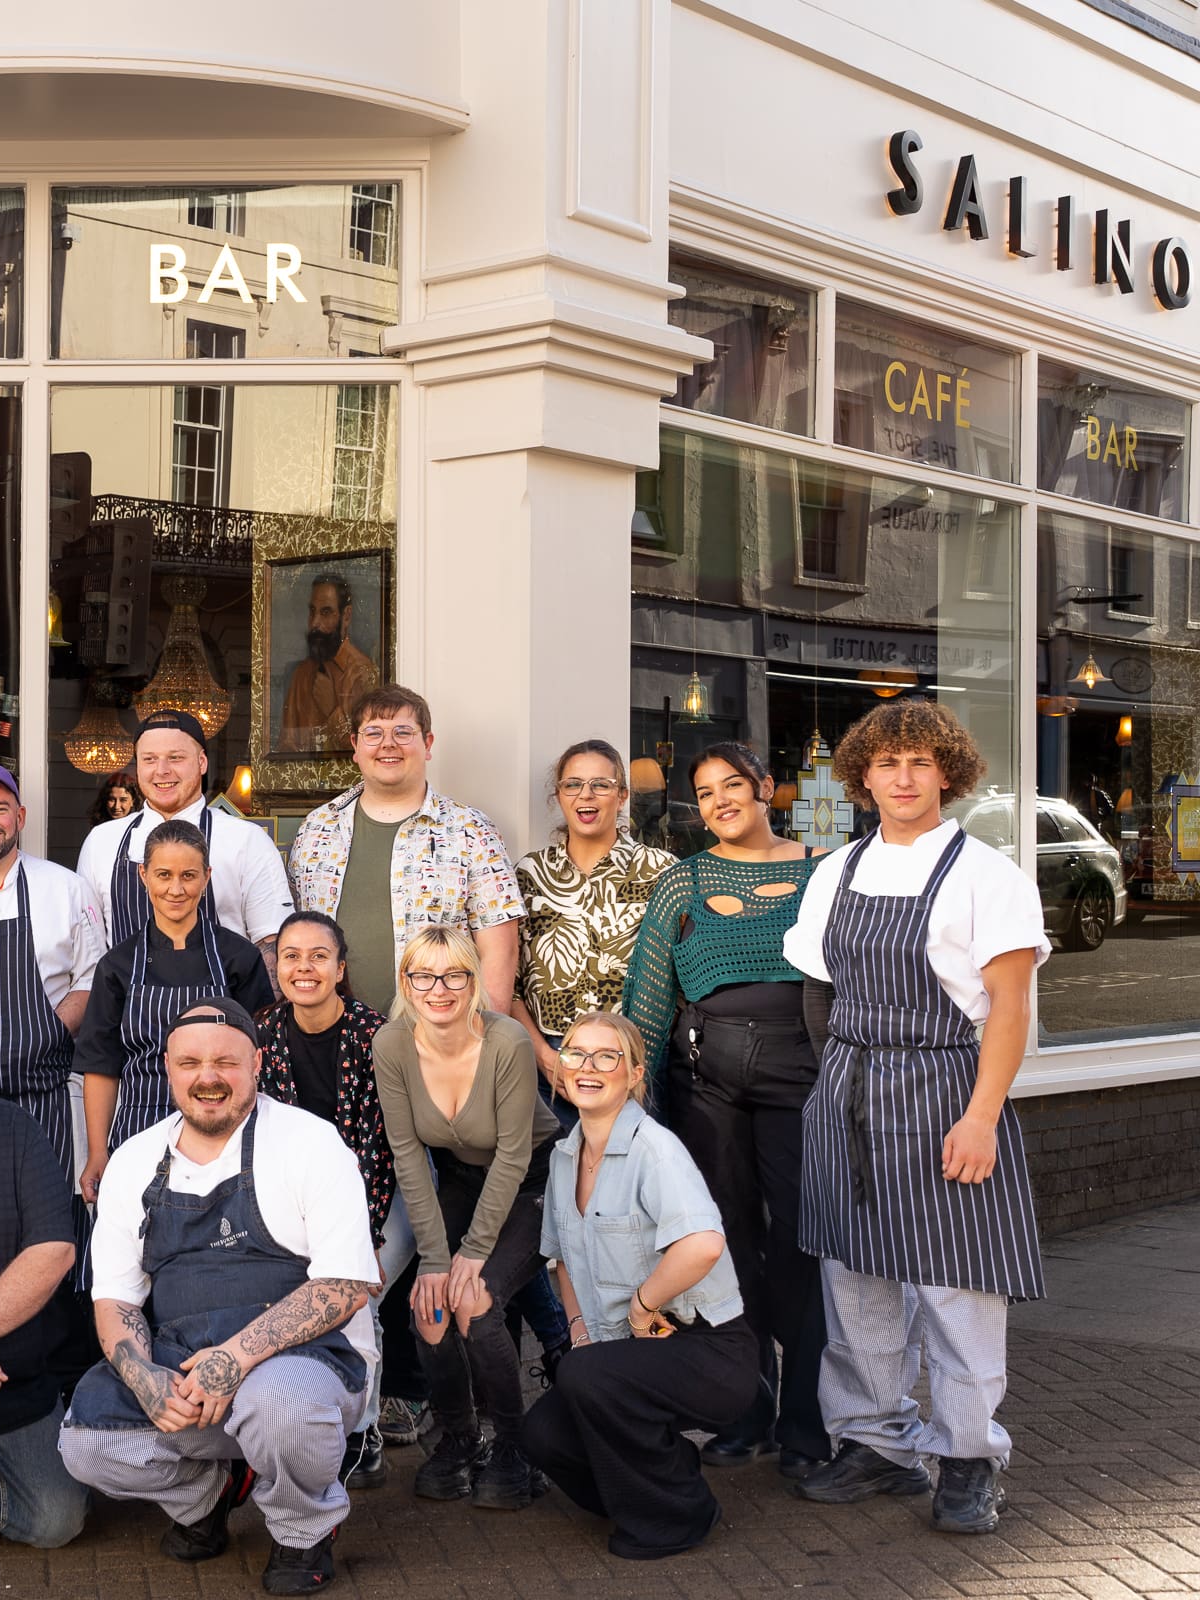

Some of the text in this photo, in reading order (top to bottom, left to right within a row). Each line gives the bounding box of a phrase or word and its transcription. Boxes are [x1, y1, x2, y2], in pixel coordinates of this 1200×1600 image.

[150, 242, 308, 305] BAR
[887, 129, 1194, 311] SALINO
[883, 361, 1139, 472] CAFÉ BAR
